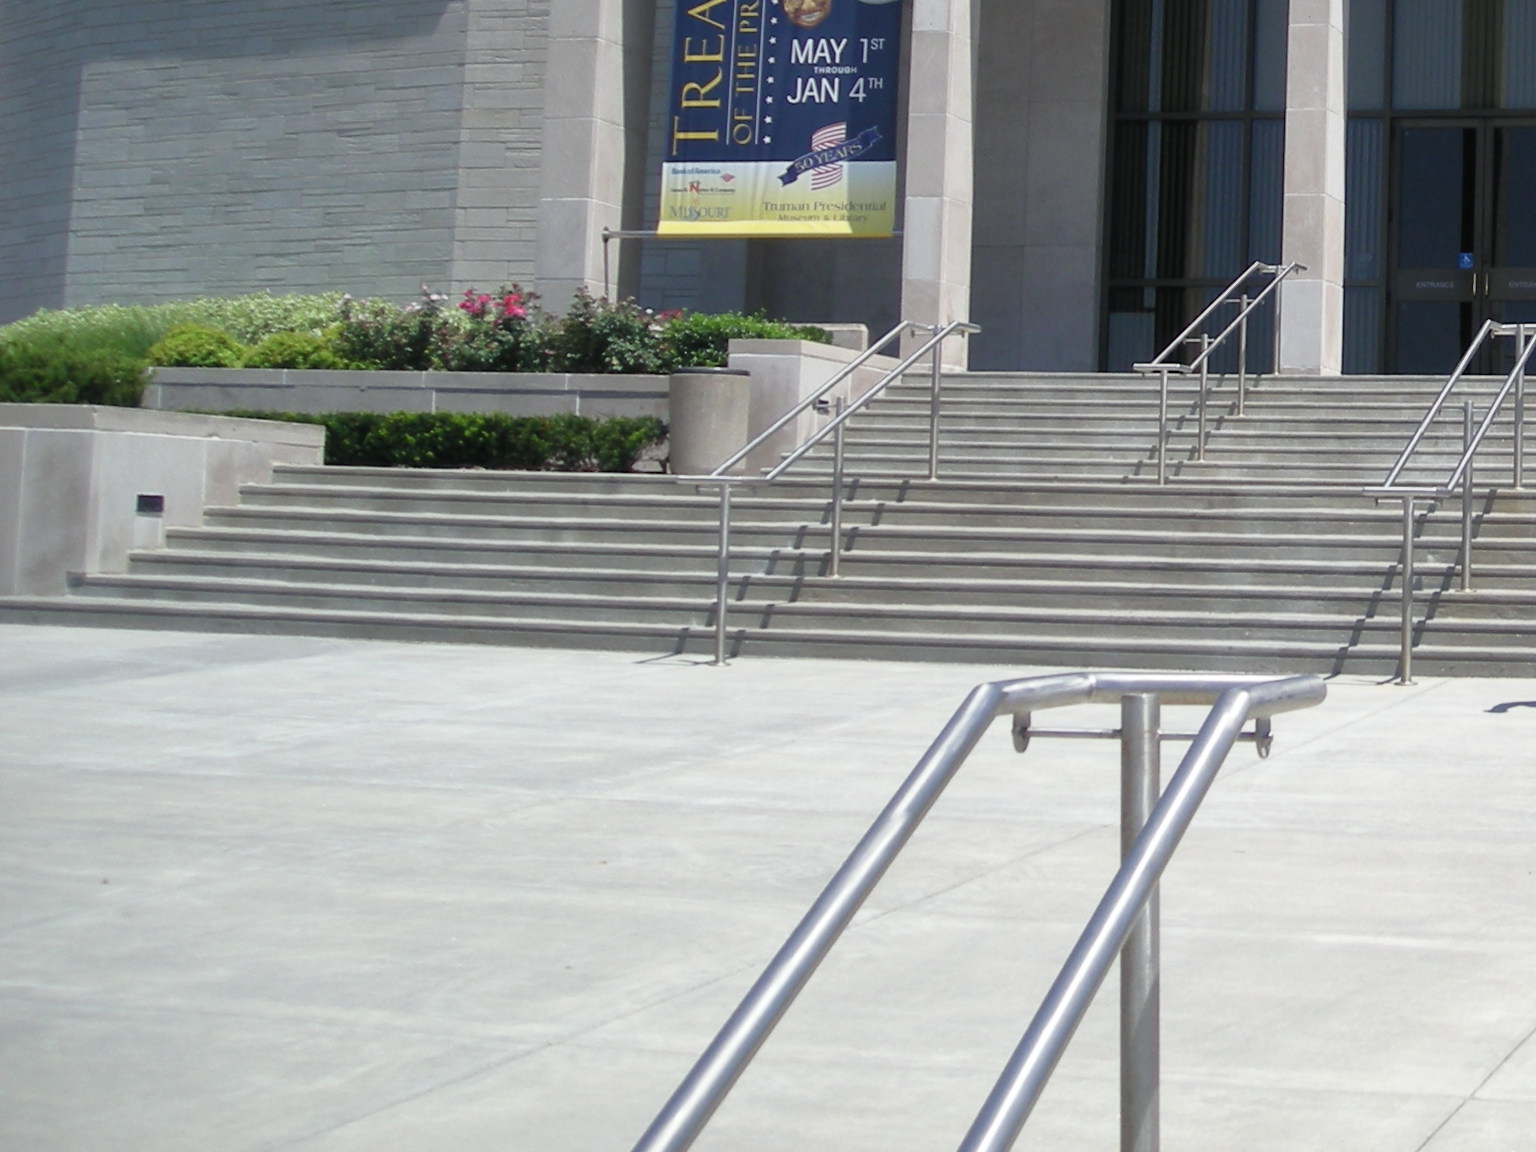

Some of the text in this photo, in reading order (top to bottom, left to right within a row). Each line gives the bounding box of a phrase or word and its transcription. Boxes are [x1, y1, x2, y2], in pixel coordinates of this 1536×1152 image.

[790, 37, 848, 64] MAY
[734, 43, 758, 98] THE
[813, 66, 858, 75] THROUGH
[786, 77, 840, 104] JAN
[732, 107, 753, 145] OF
[794, 143, 863, 173] 50 YEARS
[763, 200, 887, 211] Truman Presidential
